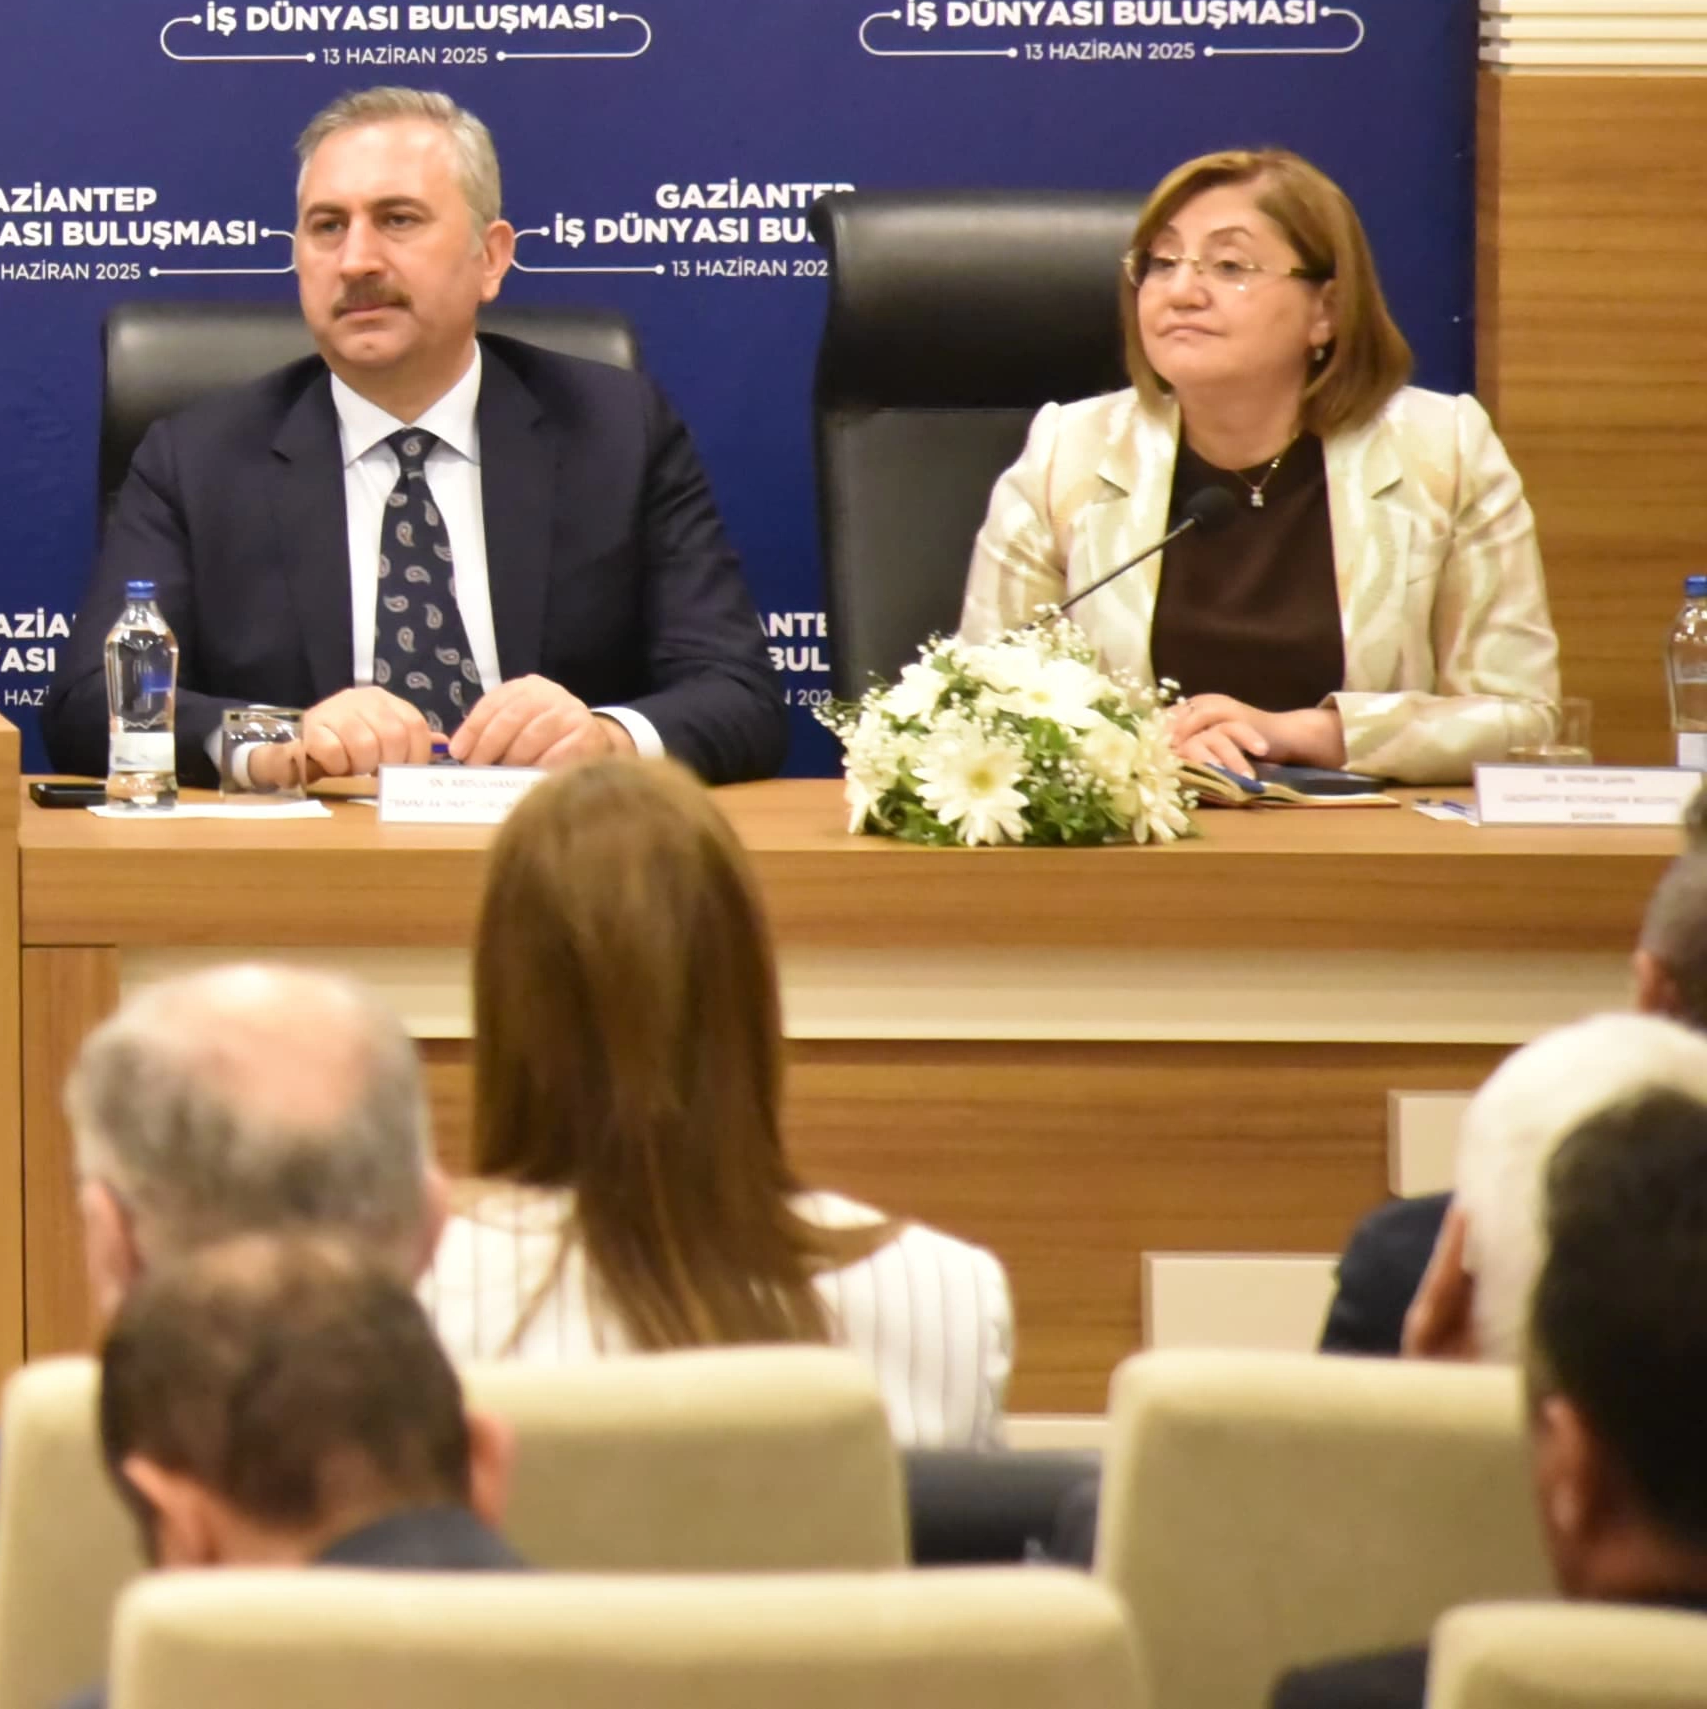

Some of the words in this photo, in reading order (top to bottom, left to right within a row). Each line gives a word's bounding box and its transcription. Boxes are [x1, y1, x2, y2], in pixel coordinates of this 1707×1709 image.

[206, 0, 238, 37] İŞ
[245, 0, 399, 32] DÜNYASI
[408, 3, 605, 35] BULUŞMASI
[322, 47, 341, 65] 13
[346, 43, 436, 65] HAZİRAN
[441, 46, 488, 65] 2025
[1024, 43, 1044, 61] 13
[1048, 38, 1142, 60] HAZİRAN
[1147, 42, 1196, 60] 2025
[655, 176, 856, 210] GAZİANT
[61, 219, 257, 251] BULUŞMASI
[554, 212, 586, 249] İŞ
[594, 211, 750, 244] DÜNYASI
[0, 259, 90, 281] HAZİRAN
[95, 262, 142, 280] 2025
[671, 260, 691, 277] 13
[695, 256, 787, 277] HAZİRAN
[792, 259, 828, 277] 202
[797, 689, 832, 706] 202
